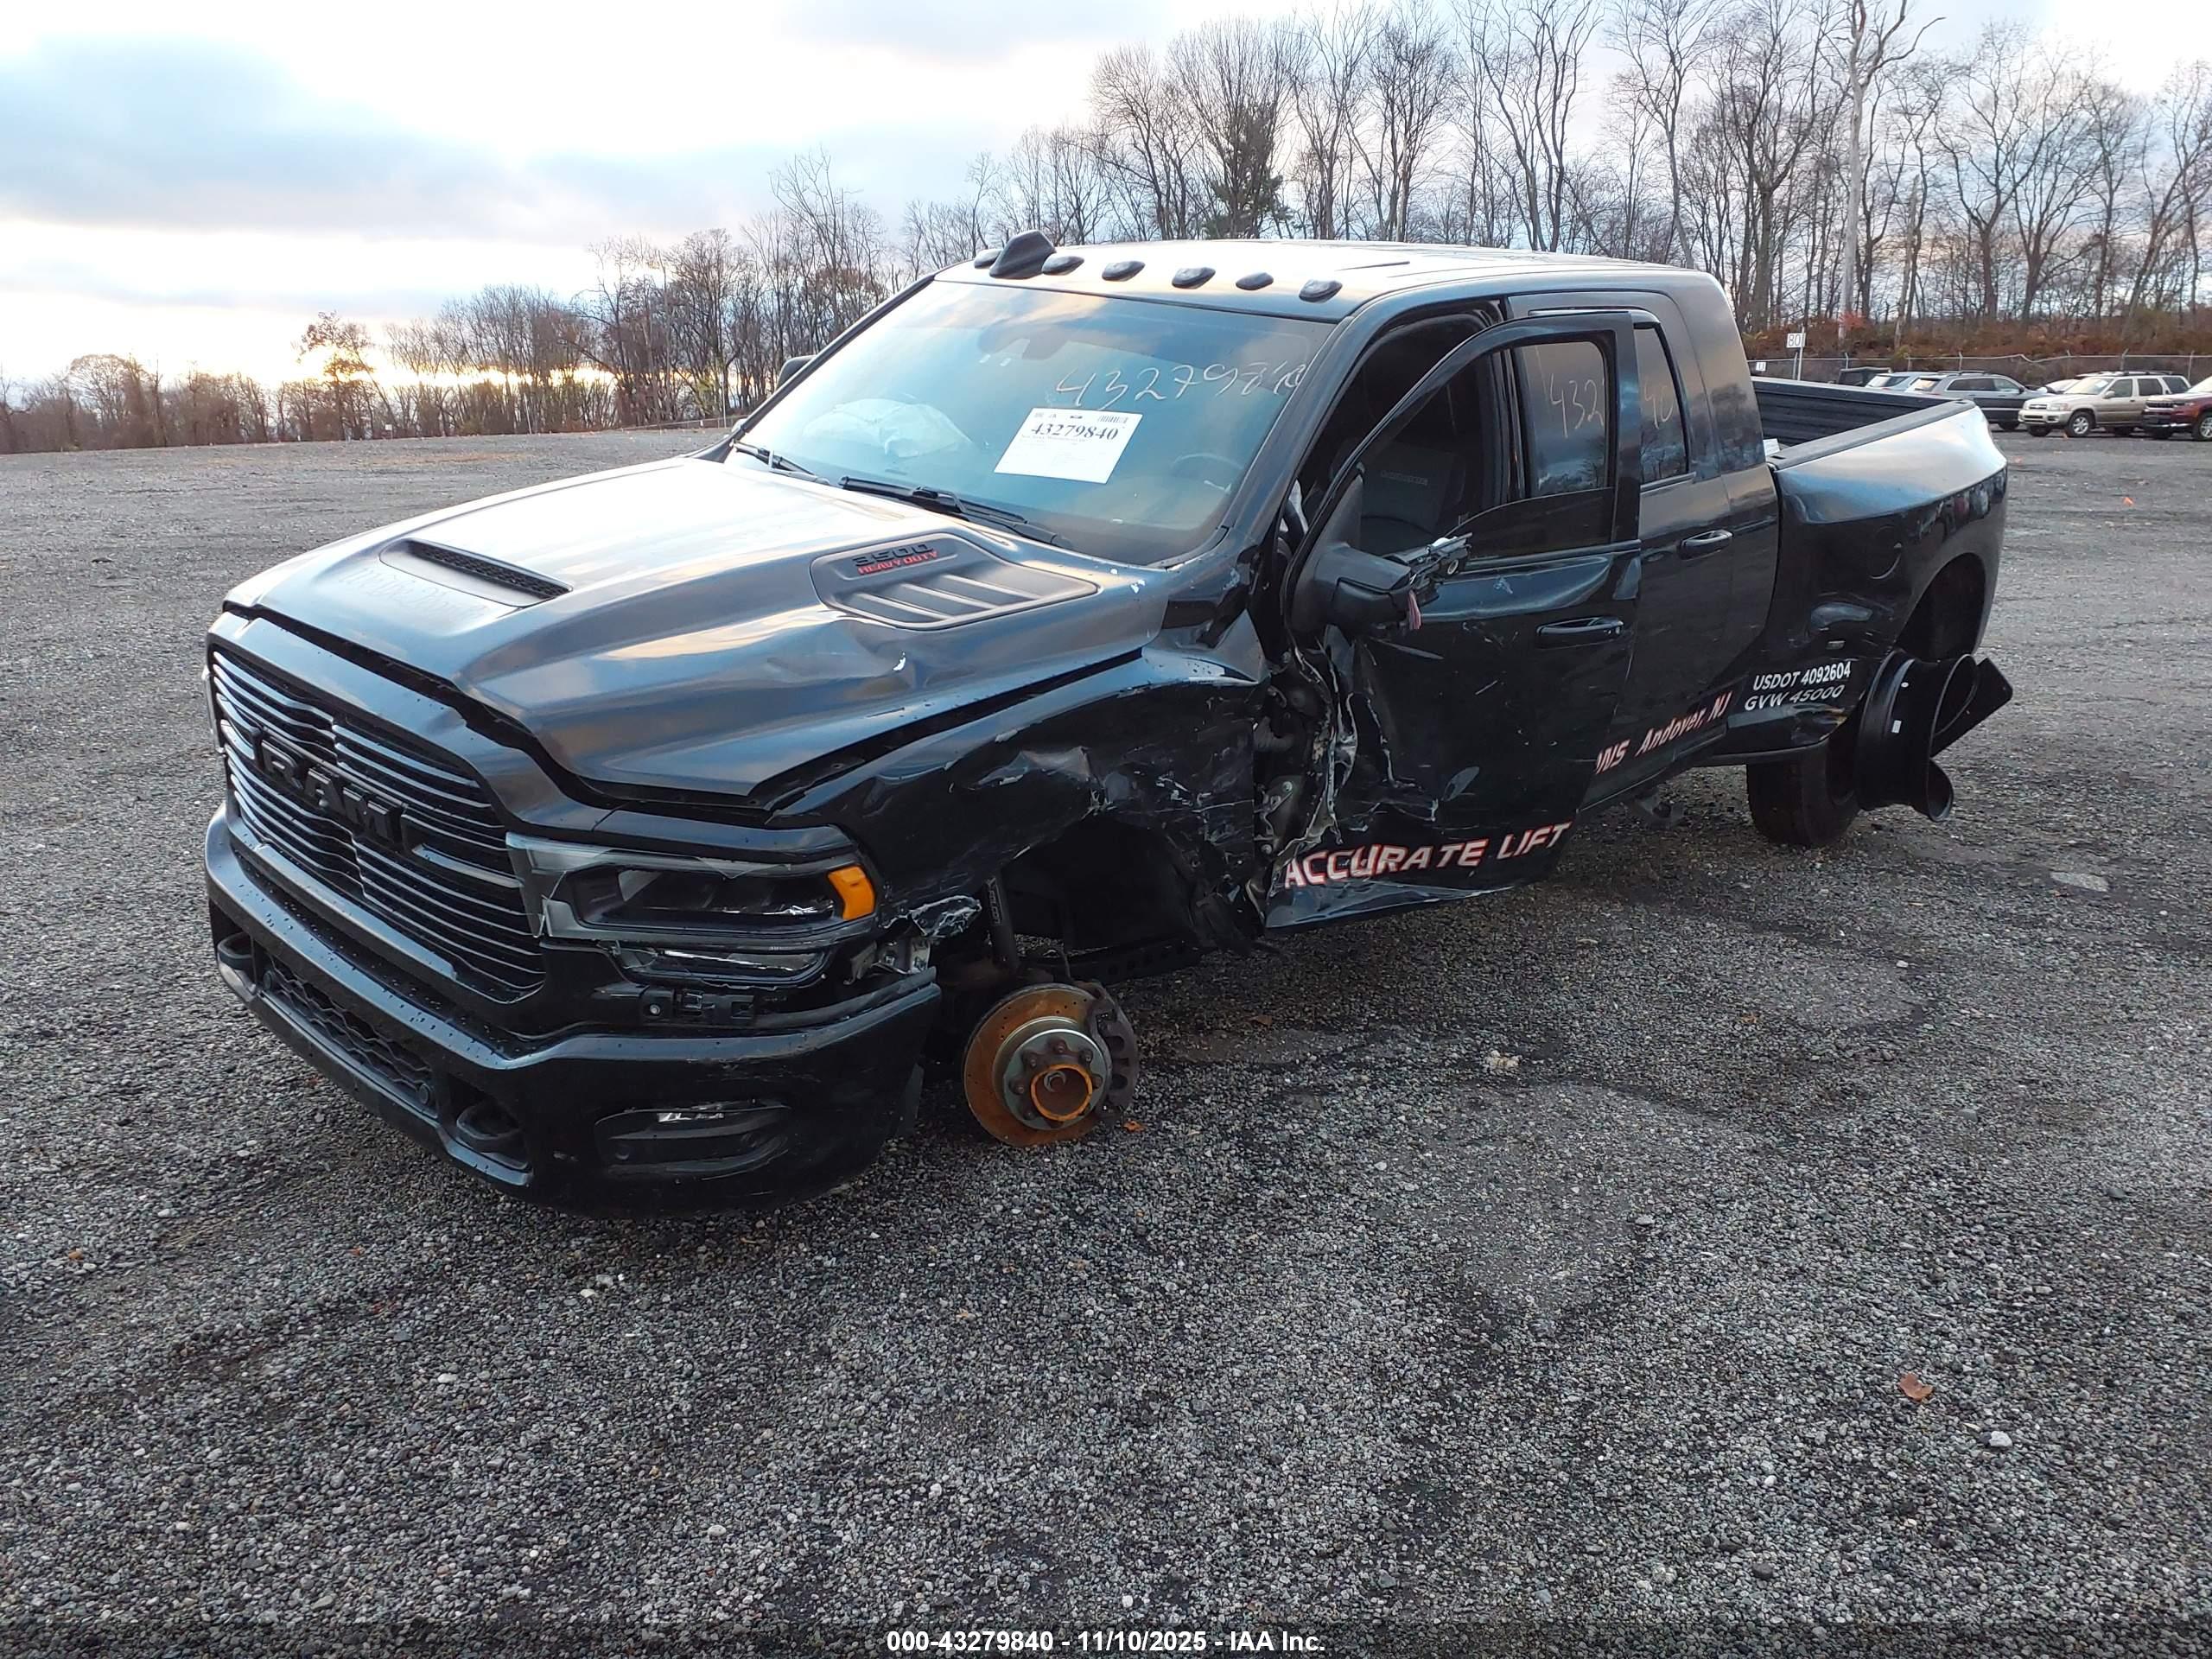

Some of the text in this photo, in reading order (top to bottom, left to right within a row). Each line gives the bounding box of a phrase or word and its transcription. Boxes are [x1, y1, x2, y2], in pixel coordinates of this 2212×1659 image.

[1031, 423, 1120, 441] 43279840
[852, 543, 934, 567] 3500
[857, 549, 939, 575] HEAVY DUTY
[1752, 660, 1852, 691] USDOT 4092604
[1745, 684, 1846, 711] GVW 45000
[1634, 707, 1707, 758] Andover,
[1706, 689, 1734, 723] NJ
[260, 740, 394, 843] RAM
[1283, 820, 1574, 890] ACCURATE LIFT
